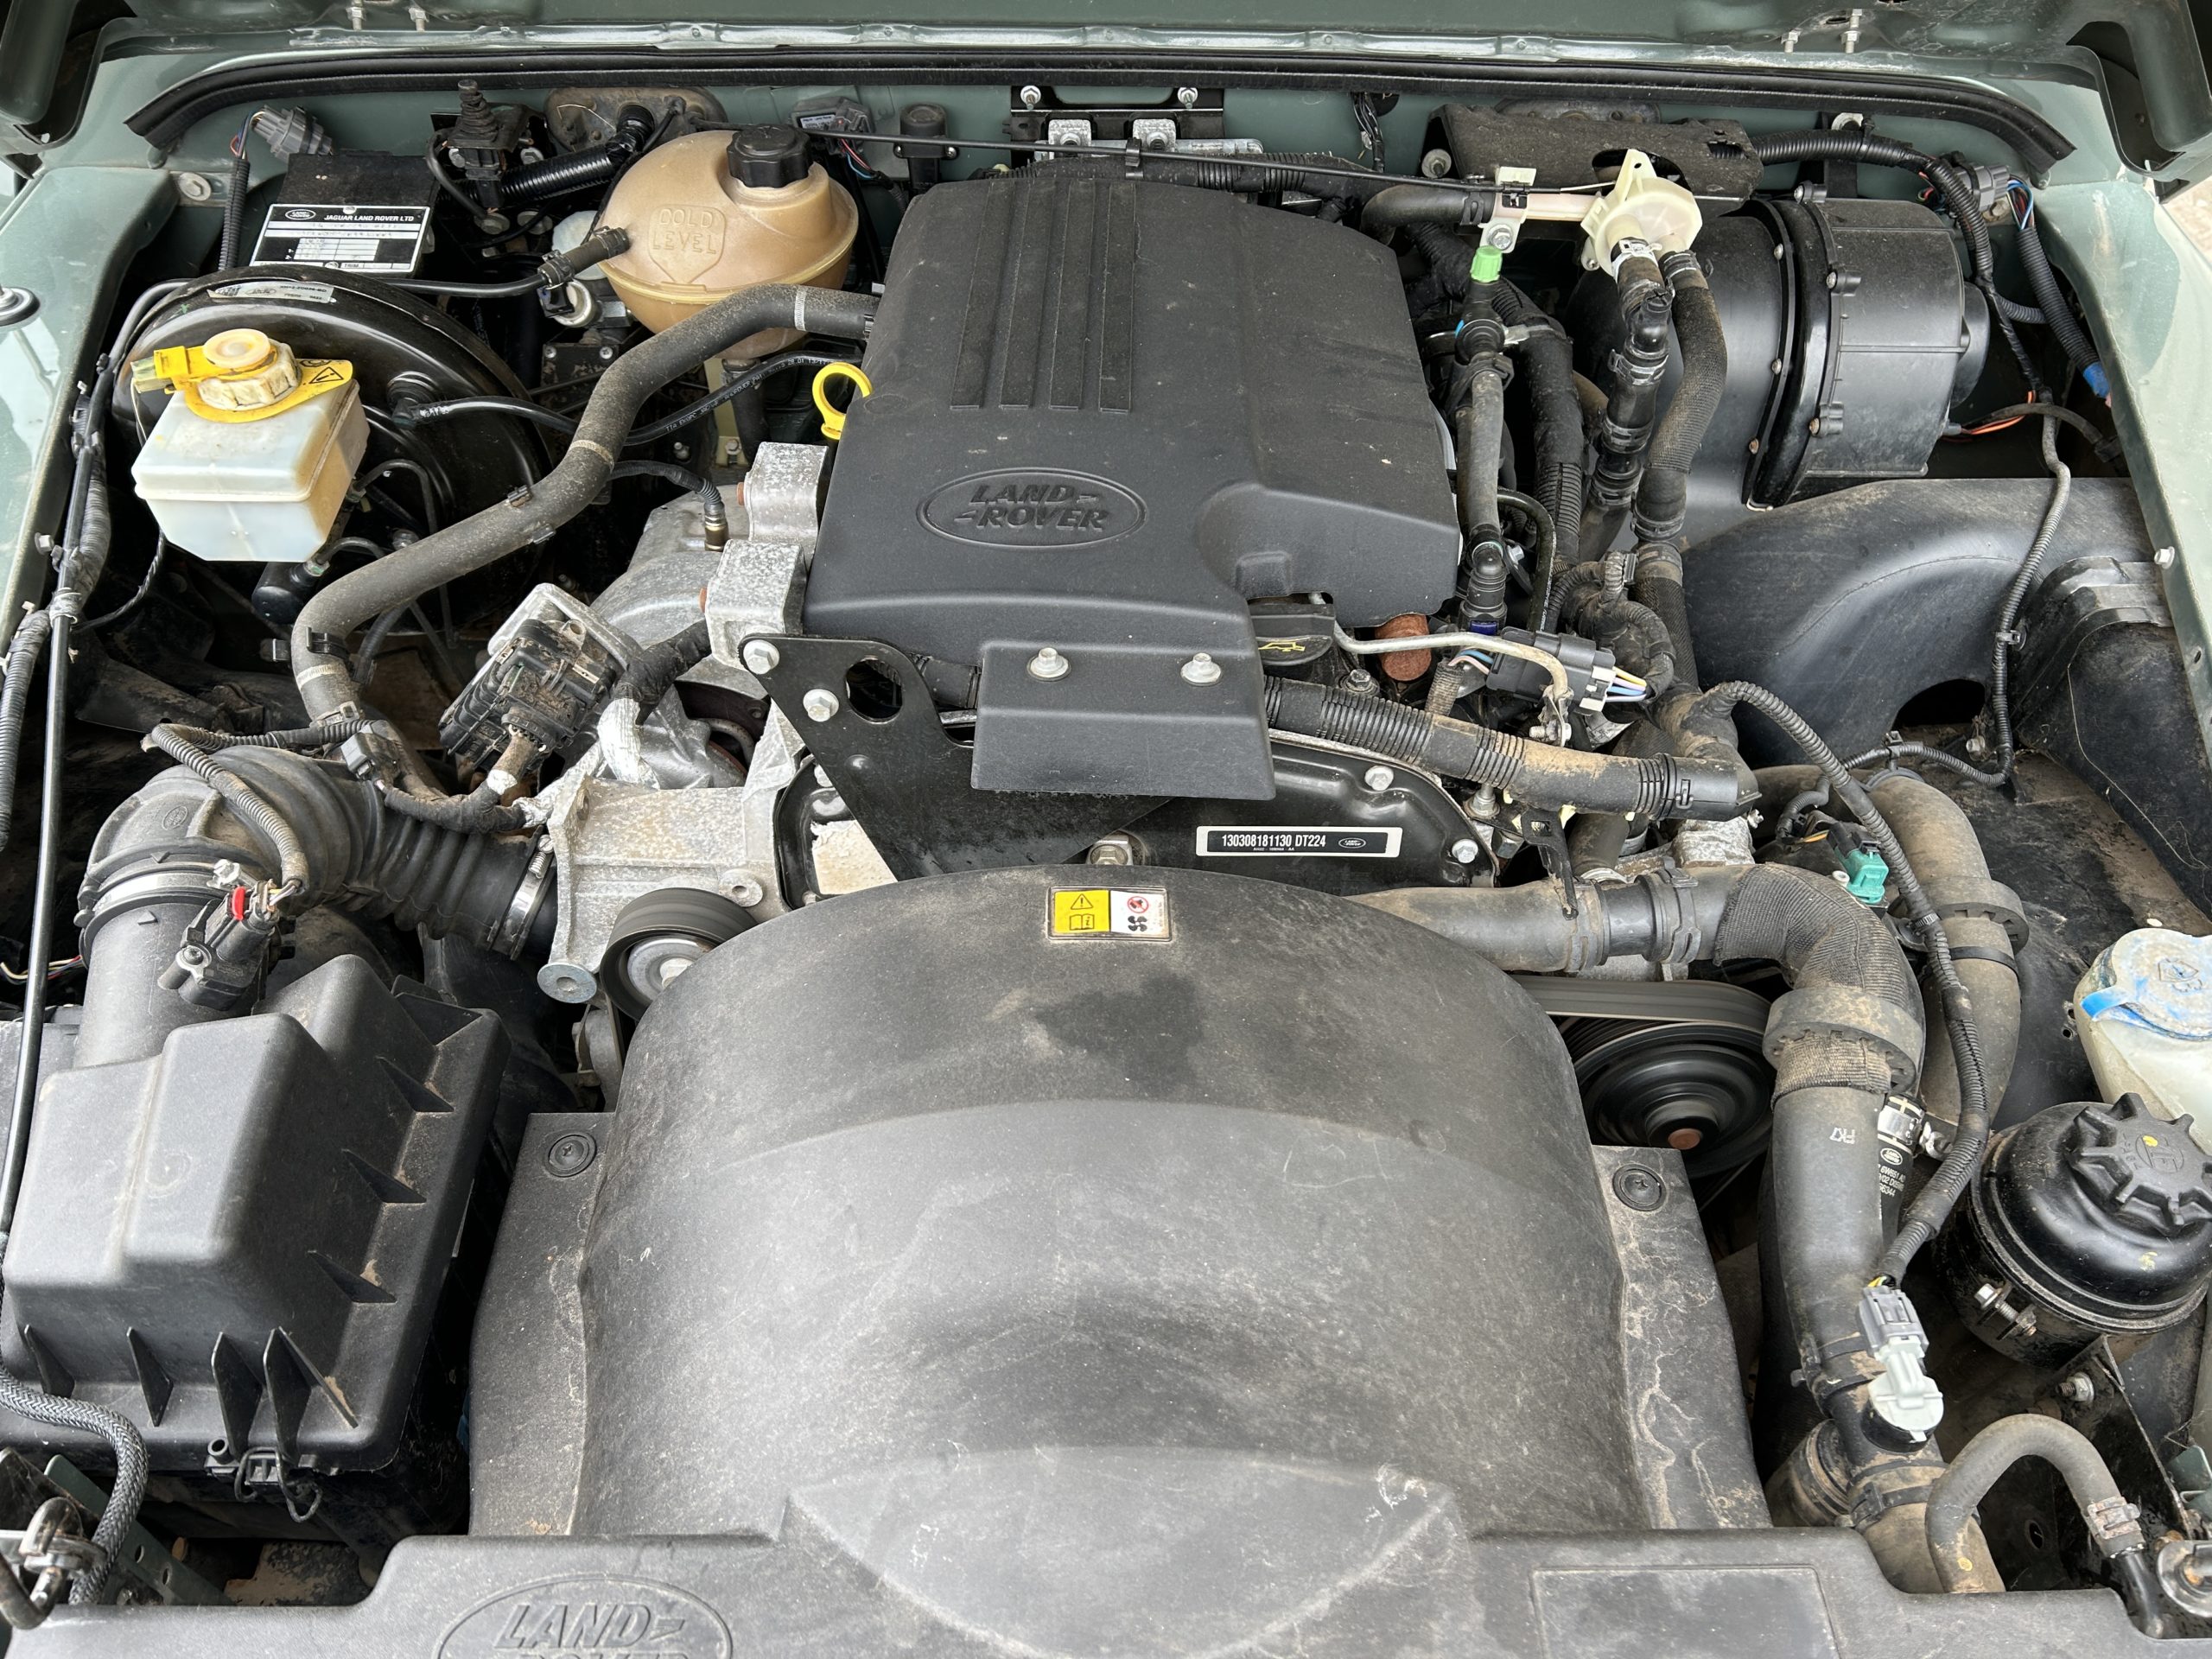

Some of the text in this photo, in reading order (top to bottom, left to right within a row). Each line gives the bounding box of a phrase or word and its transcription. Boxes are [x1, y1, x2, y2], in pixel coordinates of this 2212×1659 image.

[659, 207, 714, 229] COLD
[652, 230, 716, 255] LEVEL
[969, 484, 1075, 505] LAND
[976, 506, 1110, 532] ROVER
[1222, 834, 1326, 848] 130308181130 DT224
[493, 1602, 652, 1649] LAND
